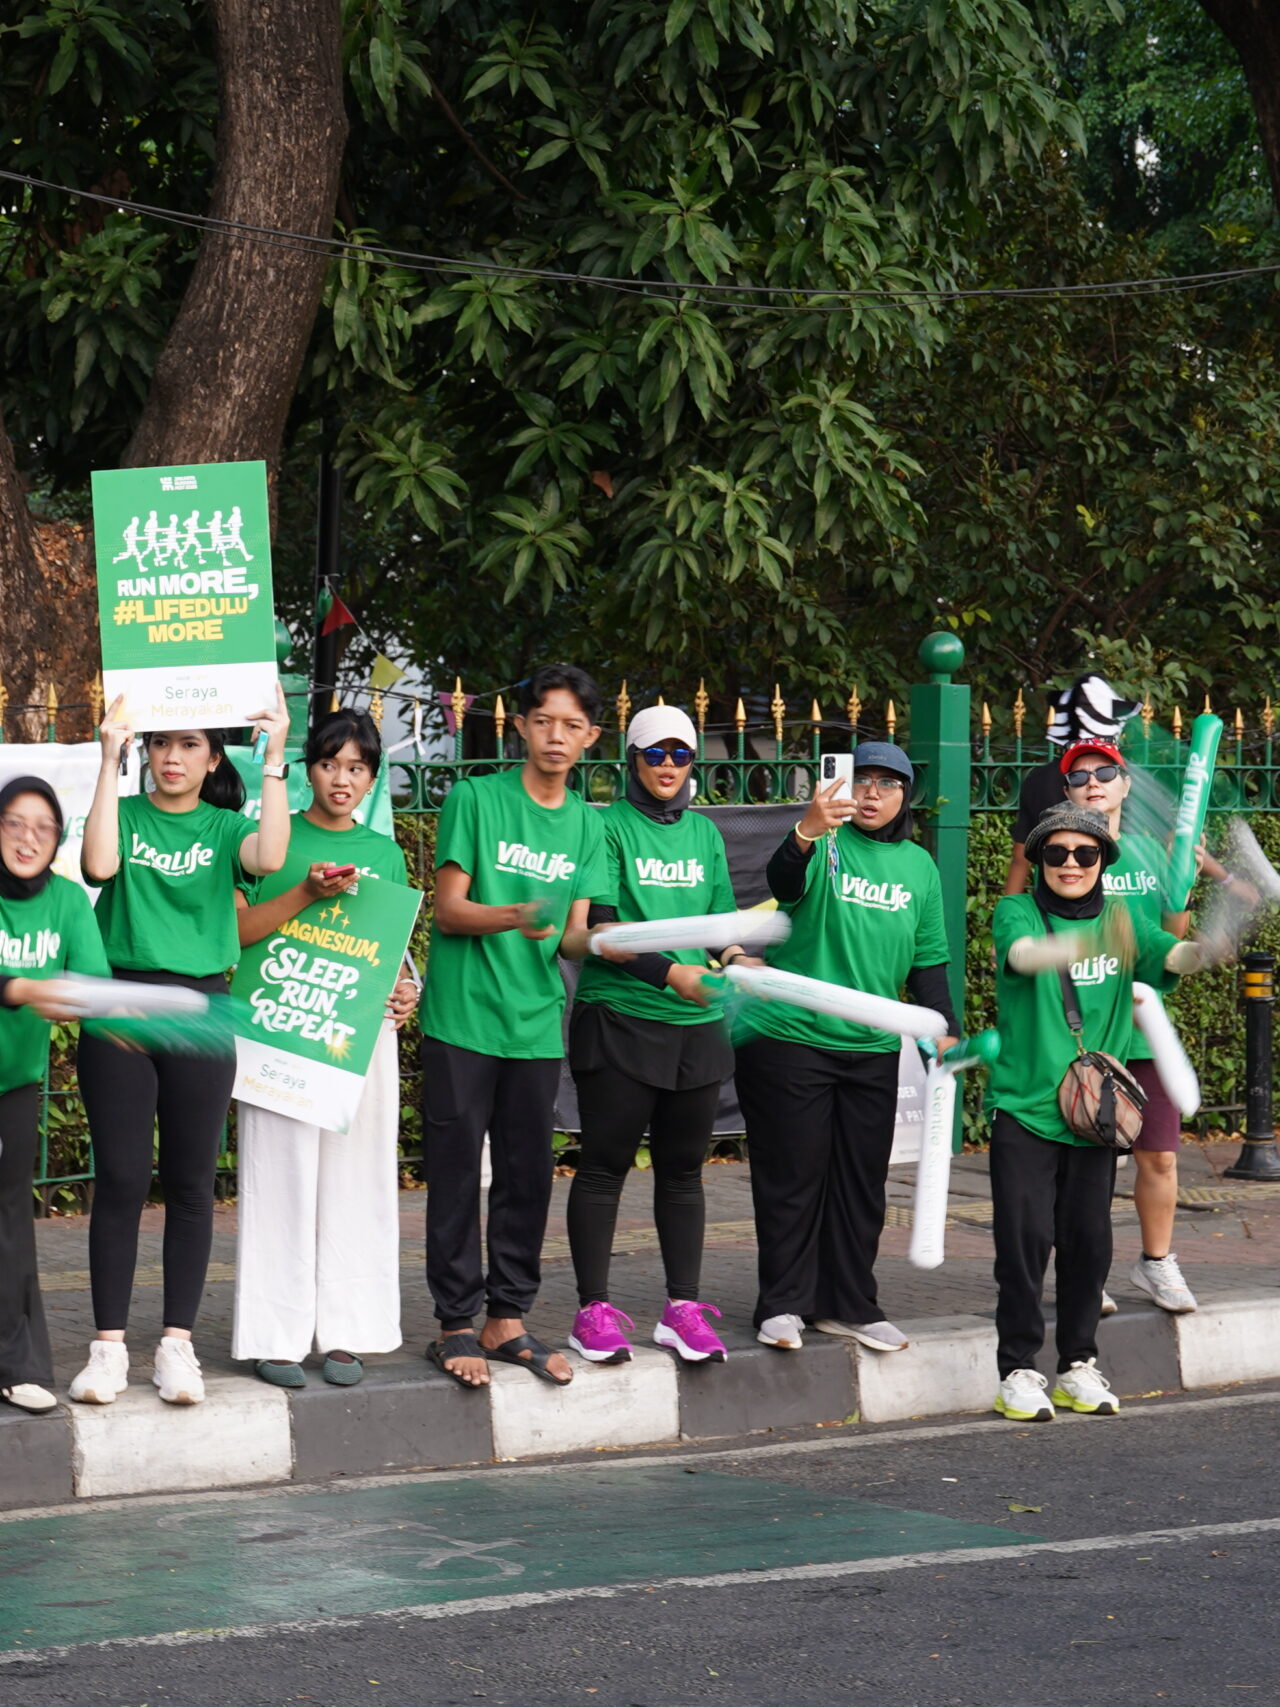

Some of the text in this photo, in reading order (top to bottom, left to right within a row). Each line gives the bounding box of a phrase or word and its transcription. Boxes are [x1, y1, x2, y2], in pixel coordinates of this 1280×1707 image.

[117, 567, 260, 600] RUN MORE,
[113, 597, 249, 626] #LIFEDULU
[148, 618, 224, 643] MORE
[165, 686, 218, 701] Seraya
[132, 832, 214, 875] VitaLife
[497, 840, 577, 883] VitaLife
[635, 857, 705, 888] VitaLife
[1101, 870, 1157, 896] itaLife
[842, 873, 912, 912] VitaLife
[260, 944, 359, 1000] SLEEP,
[279, 980, 338, 1018] RUN,
[250, 989, 356, 1049] REPEAT
[260, 1063, 306, 1089] Seraya
